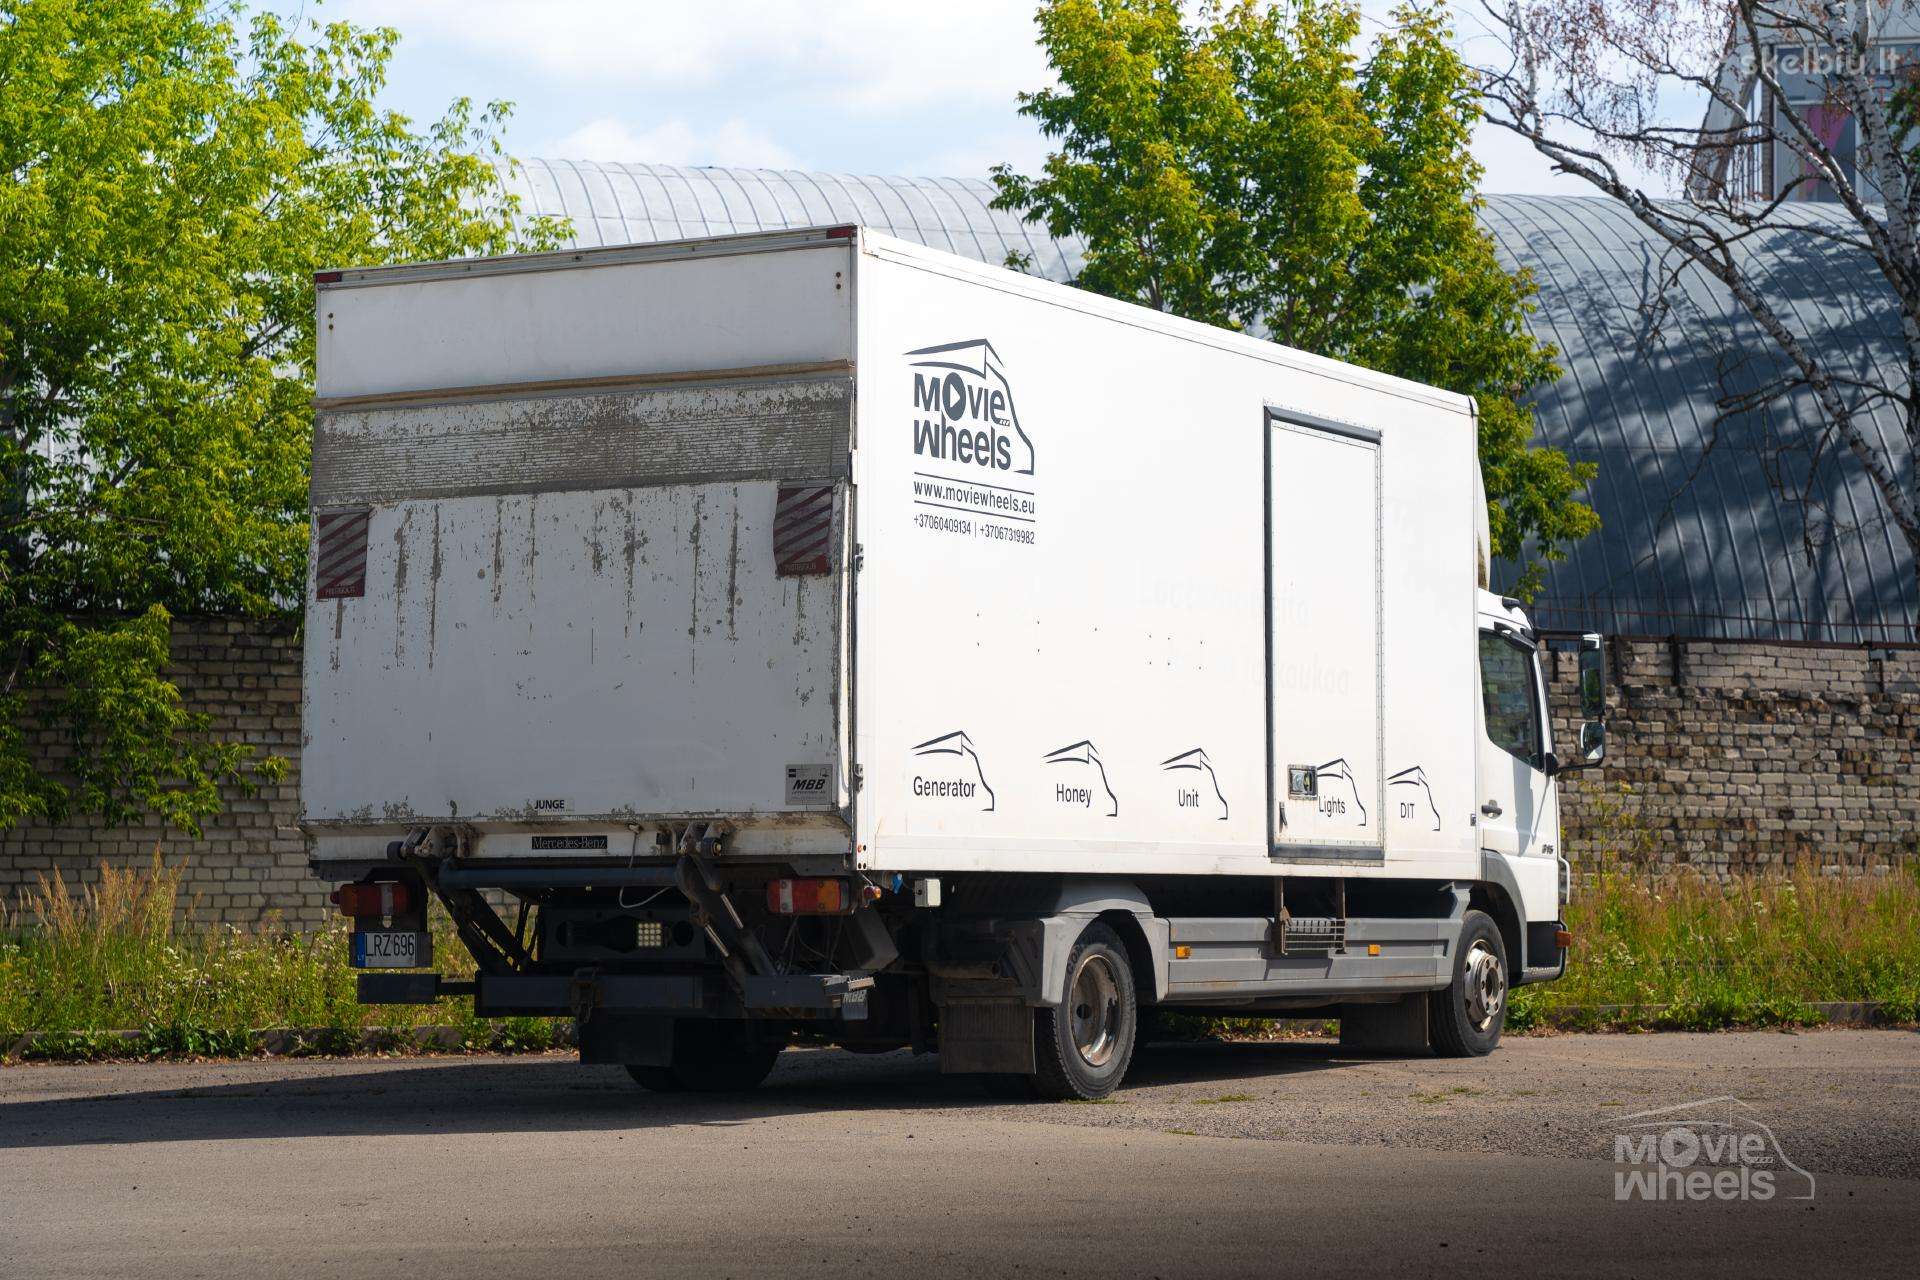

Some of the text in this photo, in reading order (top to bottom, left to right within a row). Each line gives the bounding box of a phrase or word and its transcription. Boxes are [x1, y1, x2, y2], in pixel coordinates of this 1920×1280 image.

[913, 481, 1035, 514] www.moviewheels.eu
[913, 514, 971, 535] +37060409134
[979, 522, 1035, 545] +37067319982
[792, 779, 826, 790] MBB
[913, 776, 976, 798] Generator
[534, 799, 565, 809] JUNGE
[1056, 783, 1092, 808] Honey
[1178, 789, 1199, 808] Unit
[1318, 796, 1346, 817] Lights
[1400, 802, 1415, 819] DIT
[532, 836, 607, 849] Mercedes-Benz
[365, 934, 415, 957] LRZ 696
